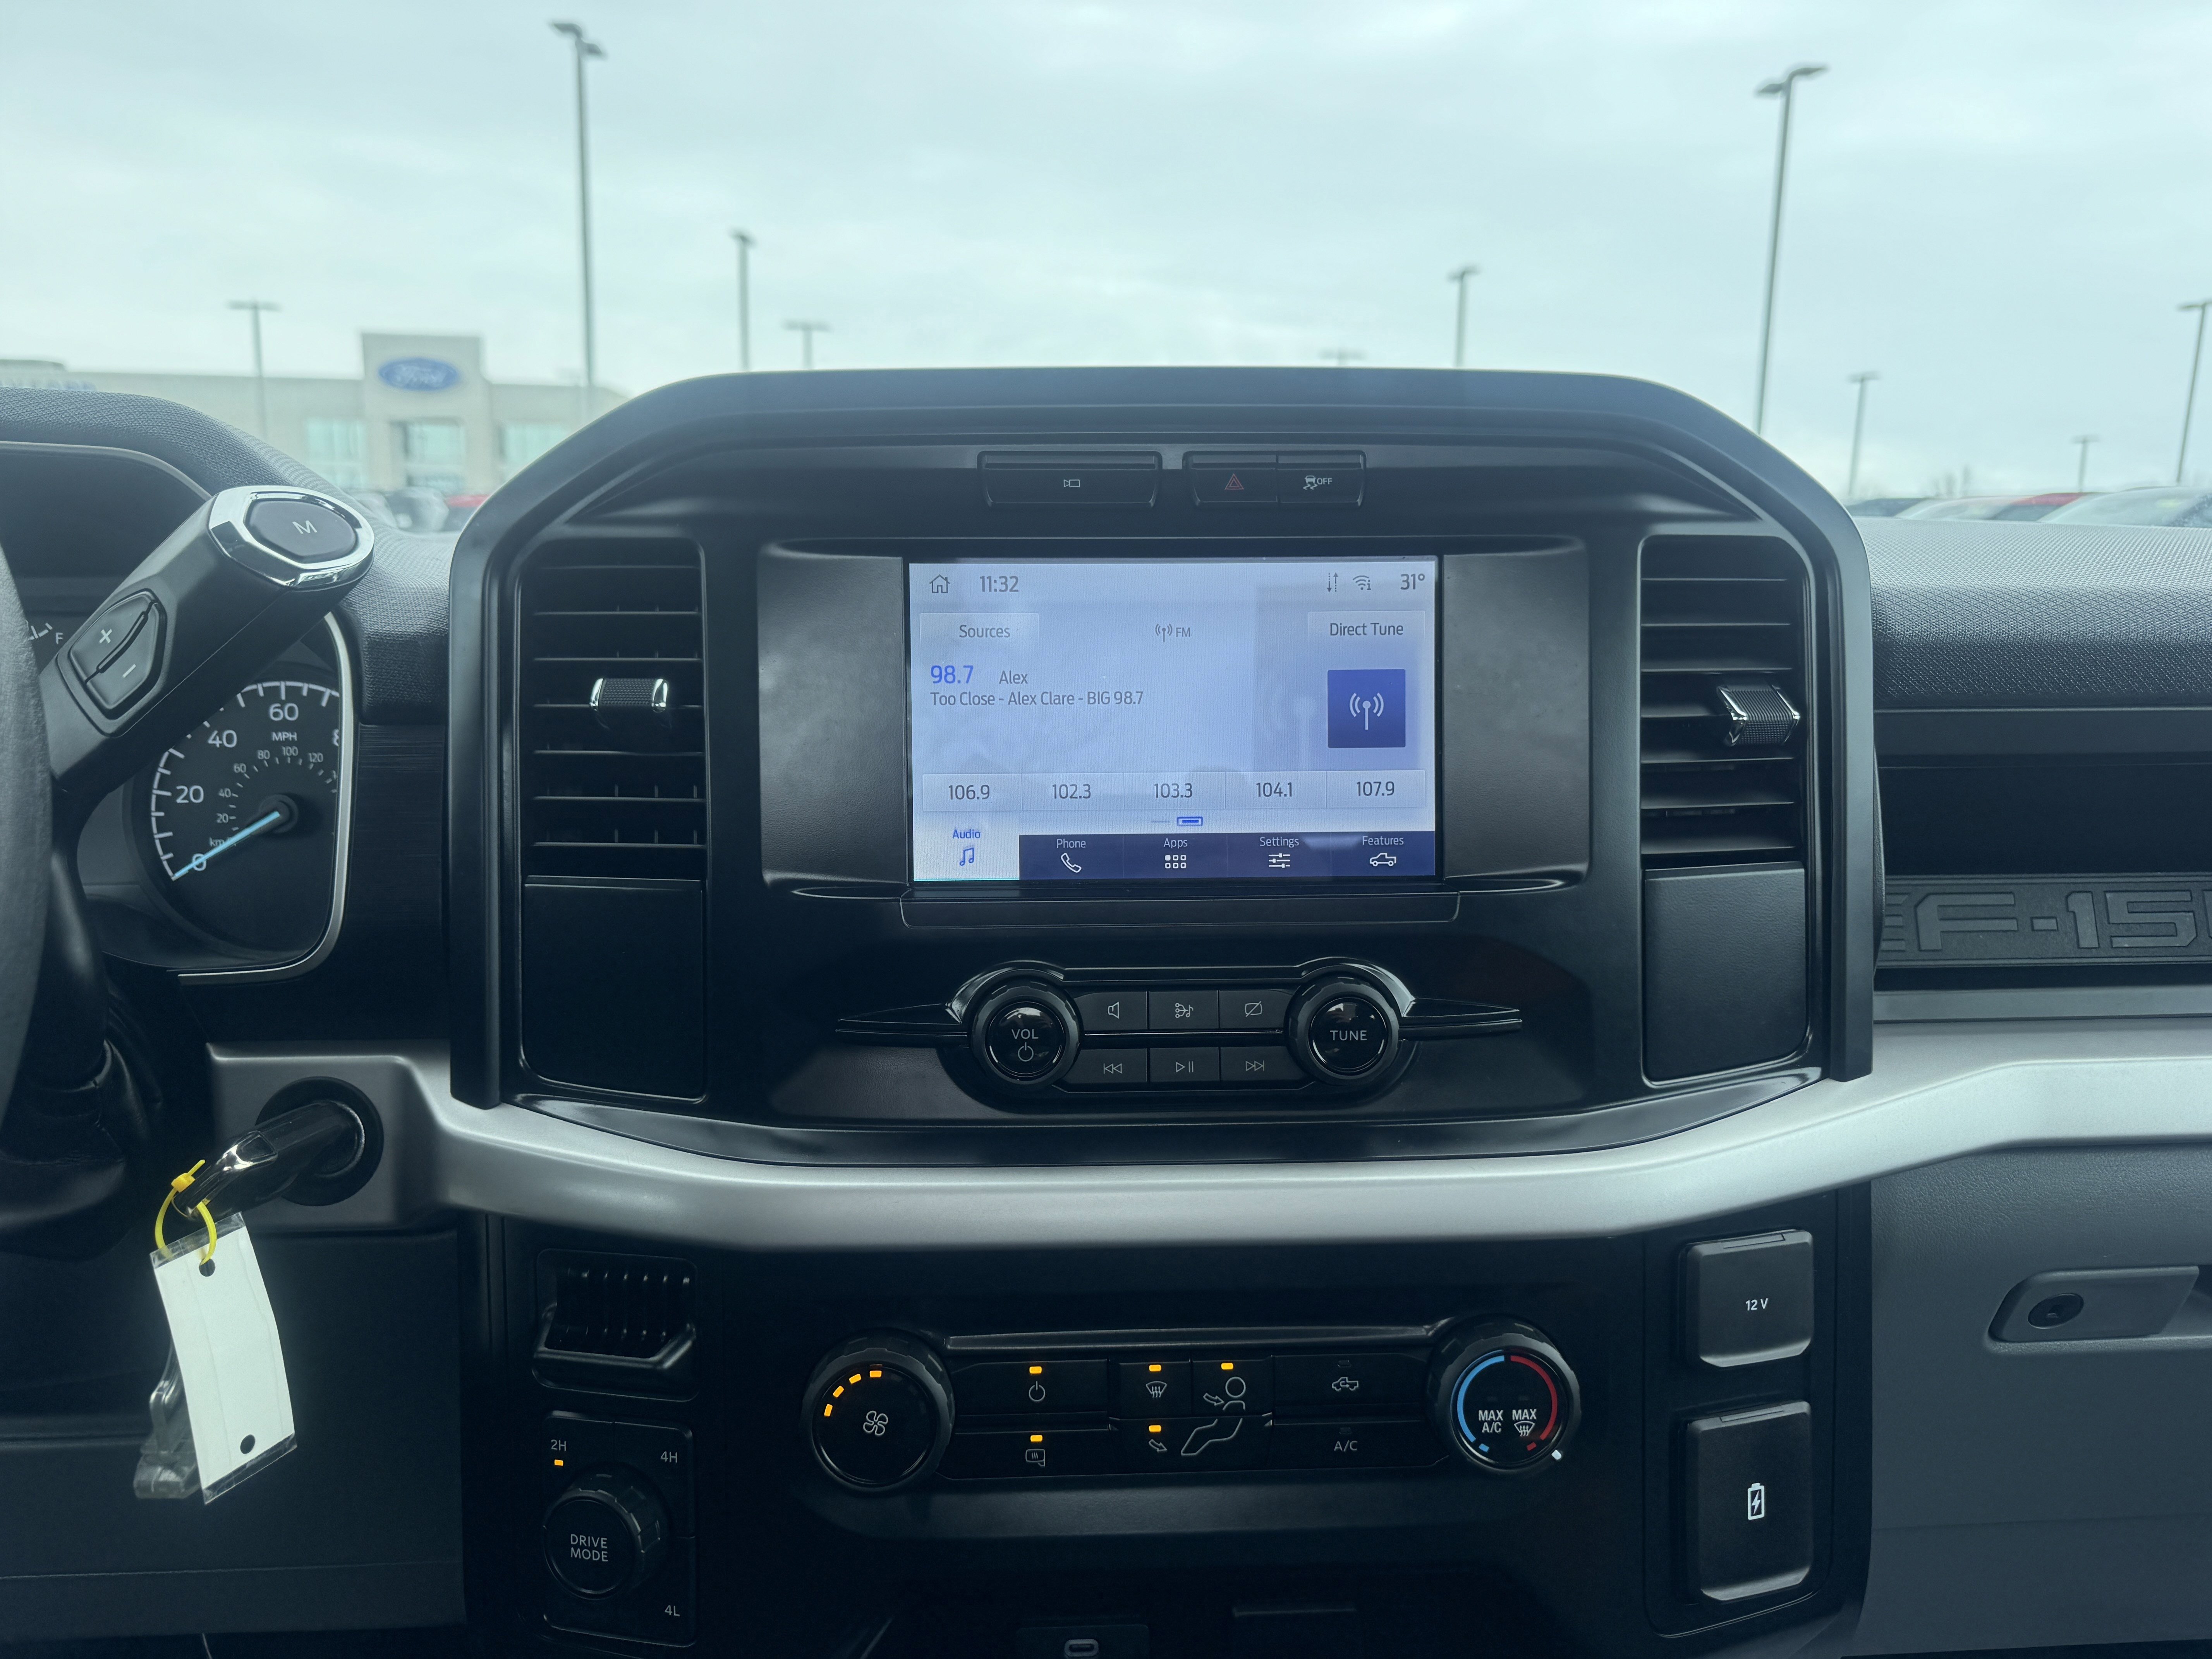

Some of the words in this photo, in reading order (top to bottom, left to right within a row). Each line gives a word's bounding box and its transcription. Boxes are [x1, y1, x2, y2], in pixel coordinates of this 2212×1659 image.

[292, 520, 318, 534] M
[980, 575, 1019, 593] 11:32
[959, 624, 1011, 638] Sources
[1176, 627, 1191, 637] FM
[1329, 622, 1367, 636] Direct
[1370, 622, 1404, 635] Tune
[56, 632, 64, 645] F
[930, 665, 974, 684] 98.7
[999, 670, 1028, 684] Alex
[930, 692, 956, 706] Too
[960, 691, 995, 706] Close
[1008, 691, 1037, 705] Alex
[1041, 691, 1075, 705] Clare
[1087, 691, 1111, 705] BIG
[1114, 690, 1144, 705] 98.7
[270, 703, 299, 721] 60
[208, 730, 237, 748] 40
[272, 731, 297, 742] MPH
[257, 750, 270, 759] 80
[282, 746, 299, 756] 100
[308, 752, 324, 763] 120
[234, 763, 246, 773] 60
[176, 785, 204, 803] 20
[218, 788, 231, 798] 40
[948, 784, 991, 800] 106.9
[1052, 784, 1091, 800] 102.3
[1154, 783, 1193, 799] 103.3
[1255, 782, 1293, 797] 104.1
[1355, 781, 1395, 797] 107.9
[216, 813, 228, 823] 20
[952, 829, 981, 839] Audio
[1056, 838, 1086, 849] Phone
[1163, 838, 1188, 848] Apps
[1259, 836, 1299, 848] Settings
[1362, 836, 1404, 846] Features
[1915, 890, 2212, 951] F-15
[1012, 1029, 1039, 1040] VOL
[1330, 1030, 1368, 1041] TUNE
[1745, 1299, 1758, 1311] 12
[1760, 1298, 1769, 1310] V
[1479, 1410, 1504, 1422] MAX
[1512, 1408, 1537, 1421] MAX
[1482, 1421, 1502, 1434] A/C
[551, 1439, 567, 1451] 2H
[1334, 1440, 1358, 1453] A/C
[660, 1451, 678, 1463] 4H
[570, 1534, 608, 1549] DRIVE
[570, 1547, 608, 1562] MODE
[665, 1605, 680, 1617] 4L
